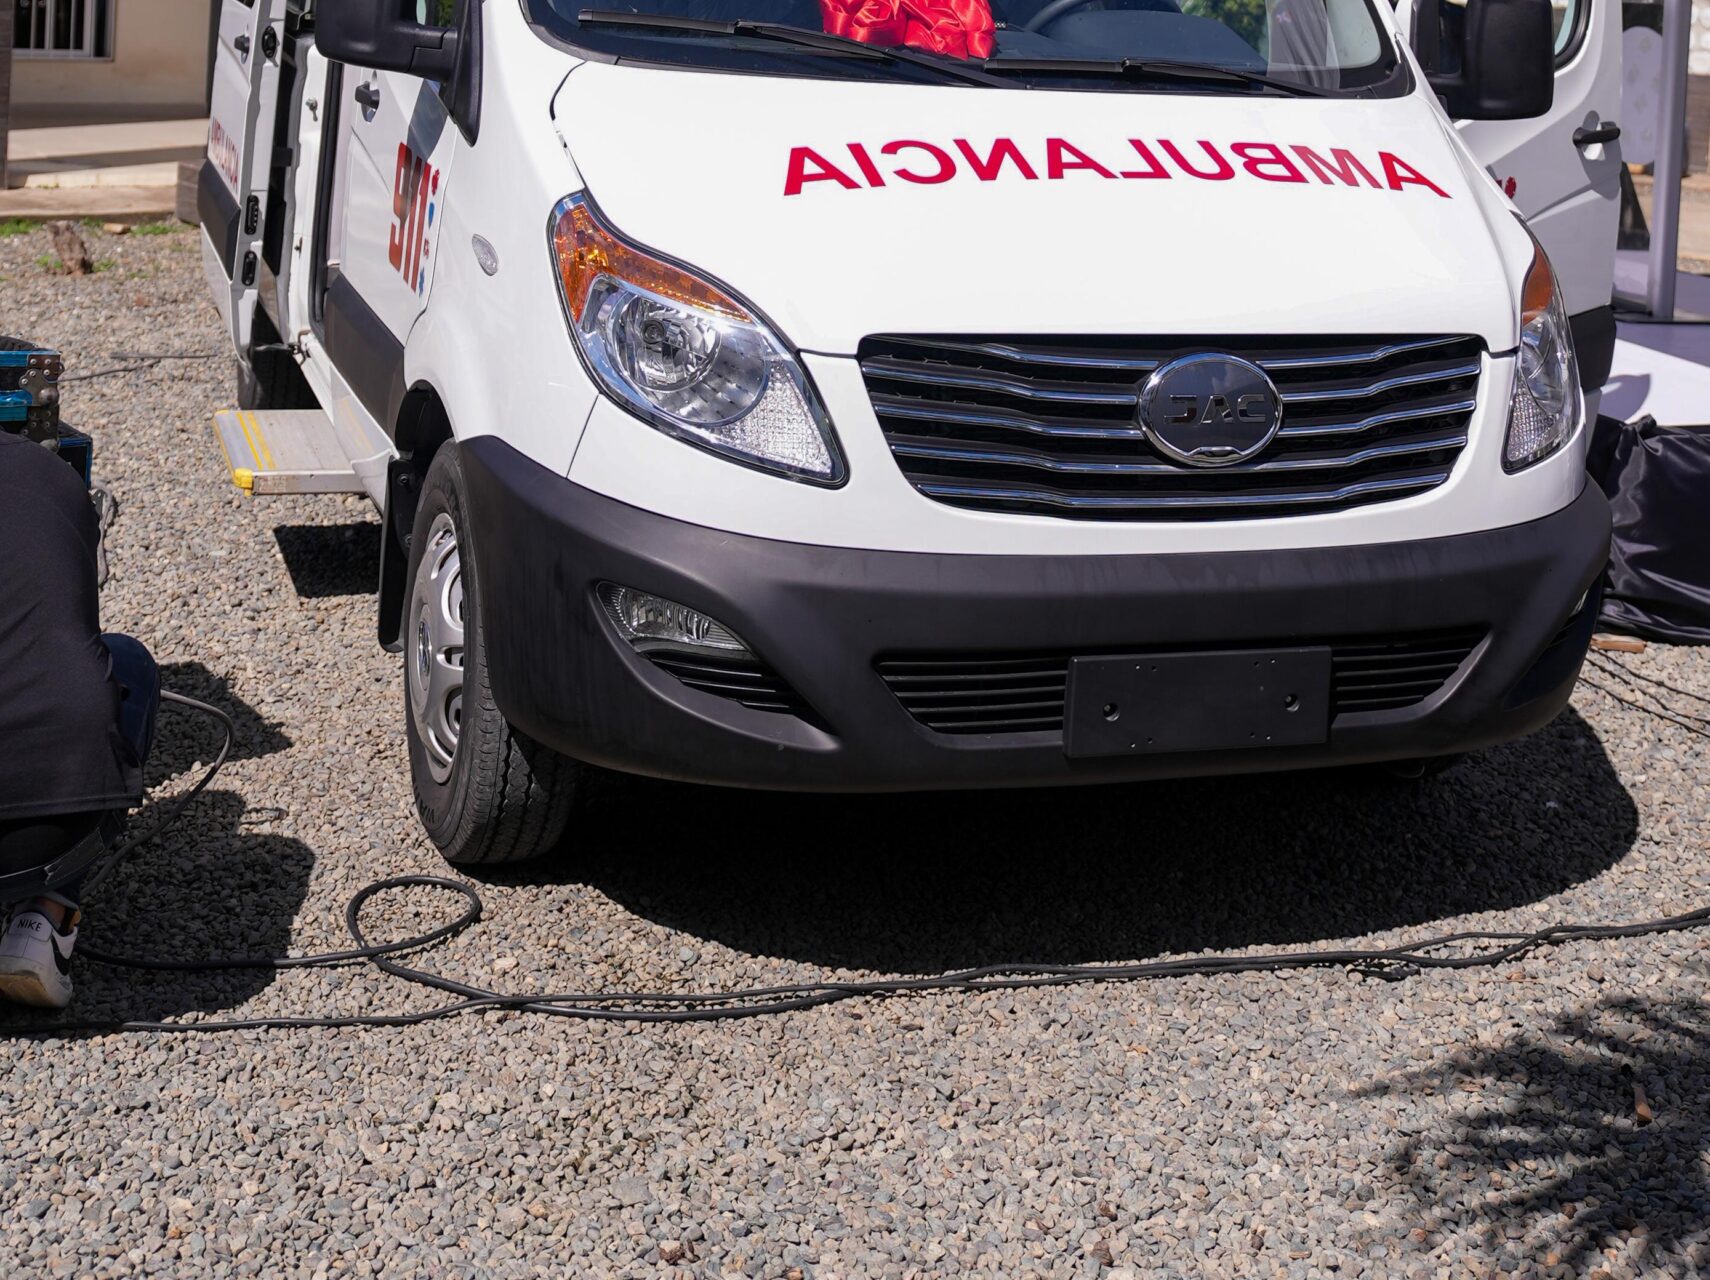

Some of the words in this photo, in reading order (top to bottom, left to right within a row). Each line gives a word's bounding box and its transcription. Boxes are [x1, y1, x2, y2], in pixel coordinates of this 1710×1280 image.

[389, 142, 431, 293] 911
[1164, 394, 1266, 423] JAC
[17, 919, 42, 932] NIKE
